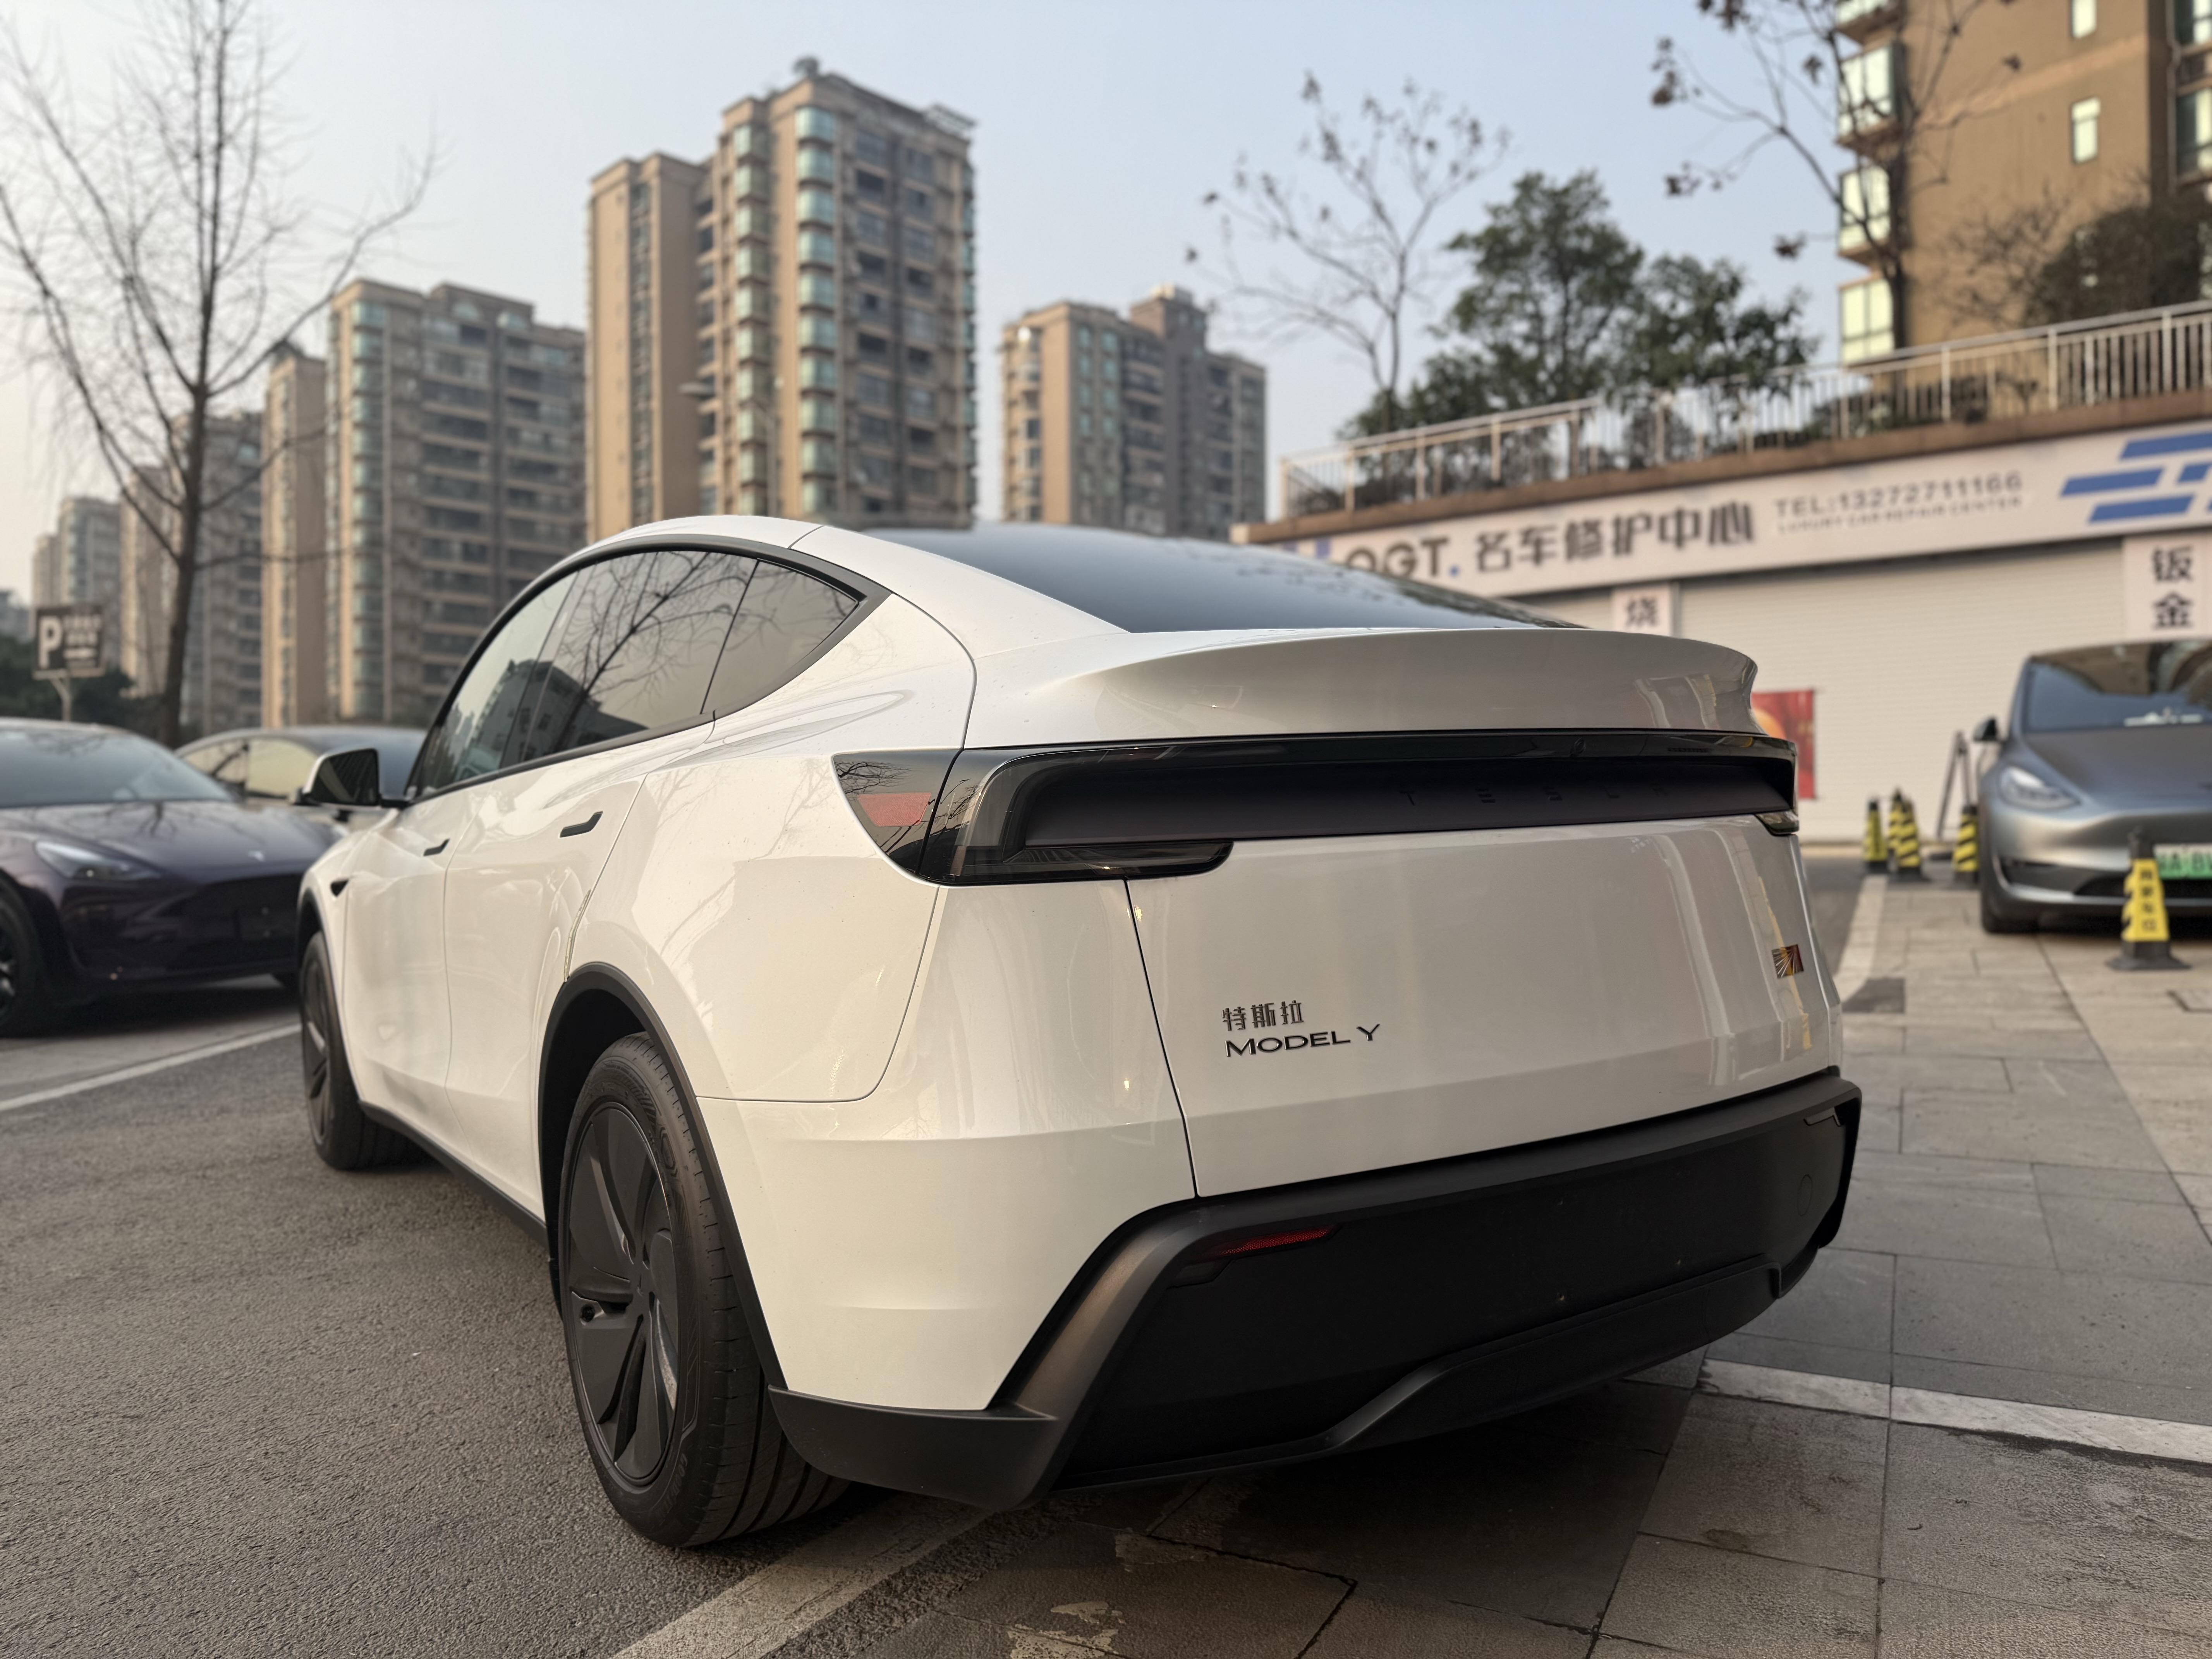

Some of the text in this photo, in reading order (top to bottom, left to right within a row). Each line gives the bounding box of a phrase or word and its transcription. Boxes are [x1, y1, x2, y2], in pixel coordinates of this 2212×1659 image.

[1476, 501, 1754, 574] 名车修护中心
[2152, 545, 2194, 629] 钣金
[39, 615, 62, 669] P
[1398, 782, 1669, 806] TESLA
[1221, 1000, 1304, 1031] 特斯拉
[1224, 1023, 1381, 1058] MODEL Y
